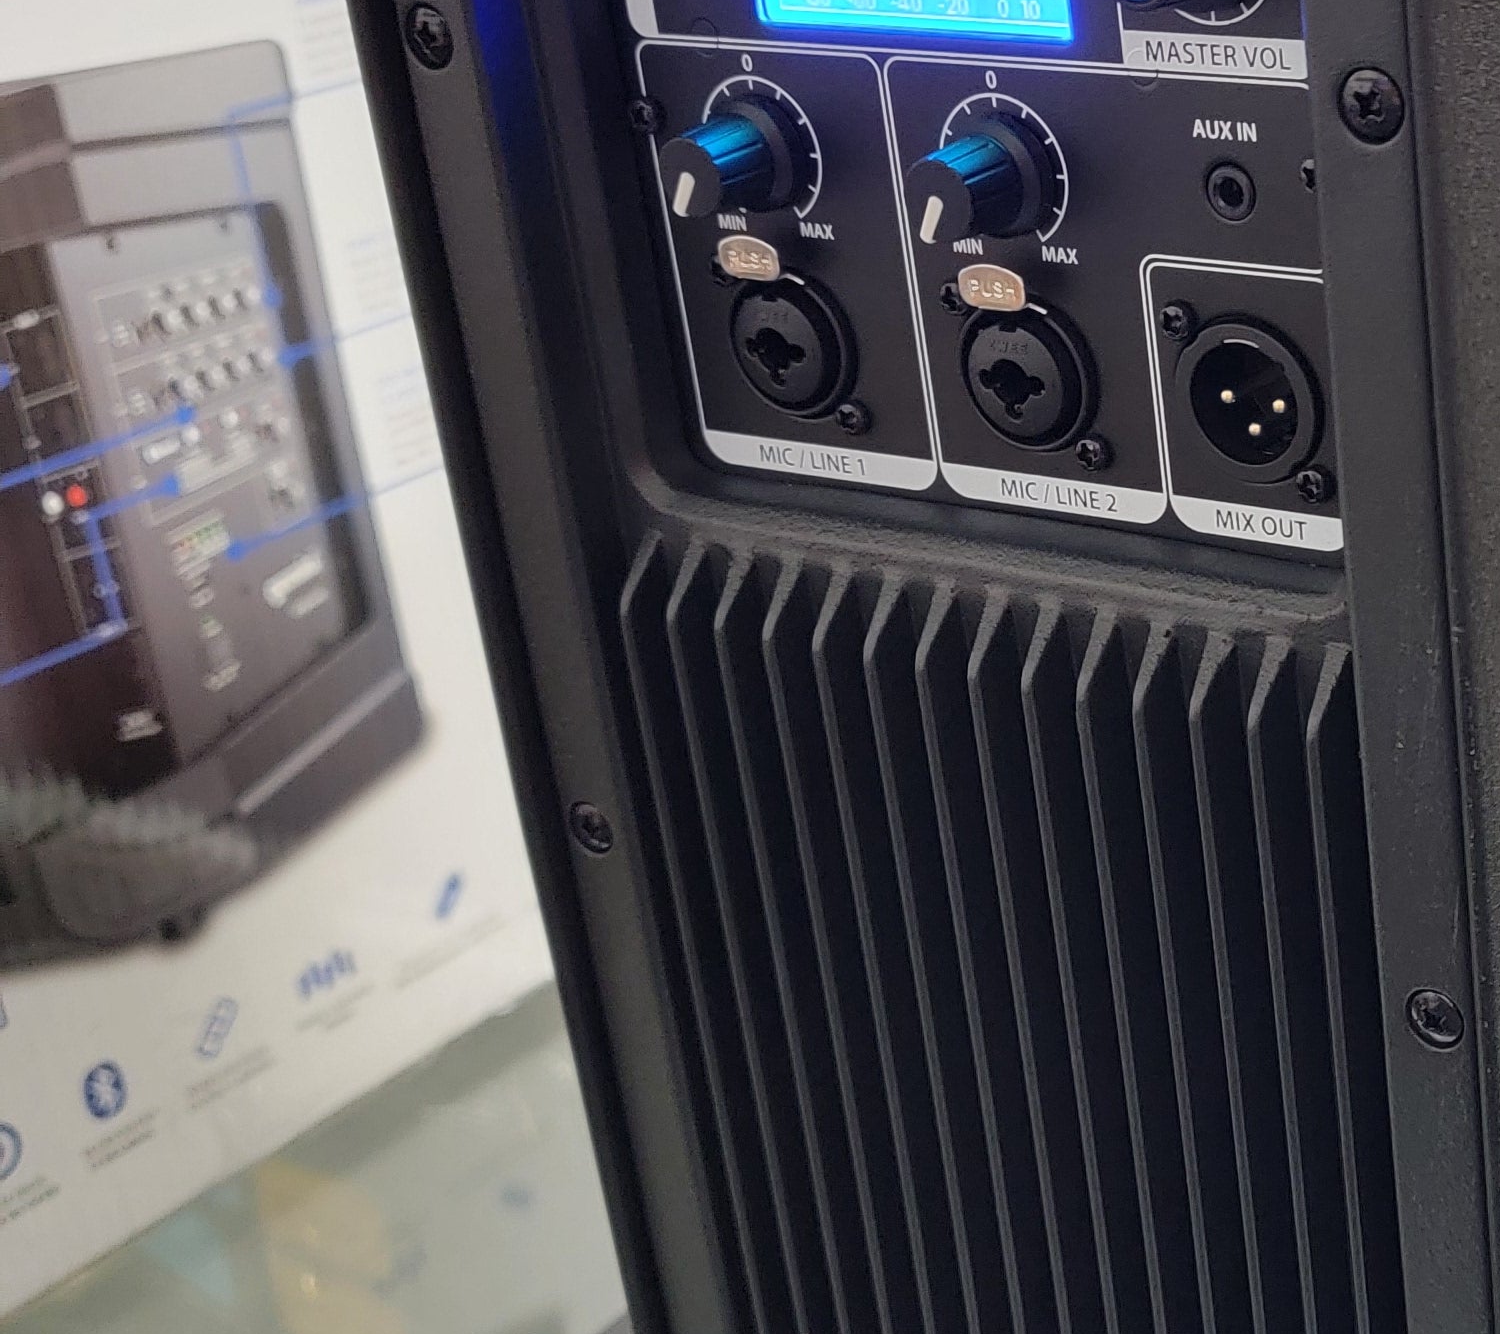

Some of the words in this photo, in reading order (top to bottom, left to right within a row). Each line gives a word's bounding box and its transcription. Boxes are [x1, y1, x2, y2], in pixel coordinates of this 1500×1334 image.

[1020, 0, 1041, 19] 10
[741, 54, 753, 72] 0
[1144, 40, 1238, 68] MASTER
[1243, 46, 1293, 71] VOL
[985, 70, 997, 89] 0
[1192, 119, 1232, 142] AUX
[1235, 121, 1258, 143] IN
[718, 214, 747, 232] MIN
[800, 222, 835, 241] MAX
[952, 238, 984, 255] MIN
[1041, 245, 1079, 265] MAX
[758, 444, 793, 467] MIC
[810, 450, 853, 475] LINE
[856, 458, 867, 476] 1
[1000, 477, 1038, 502] MIC
[1055, 485, 1100, 511] LINE
[1105, 493, 1119, 513] 2
[1215, 508, 1255, 534] MIX
[1260, 514, 1308, 542] OUT
